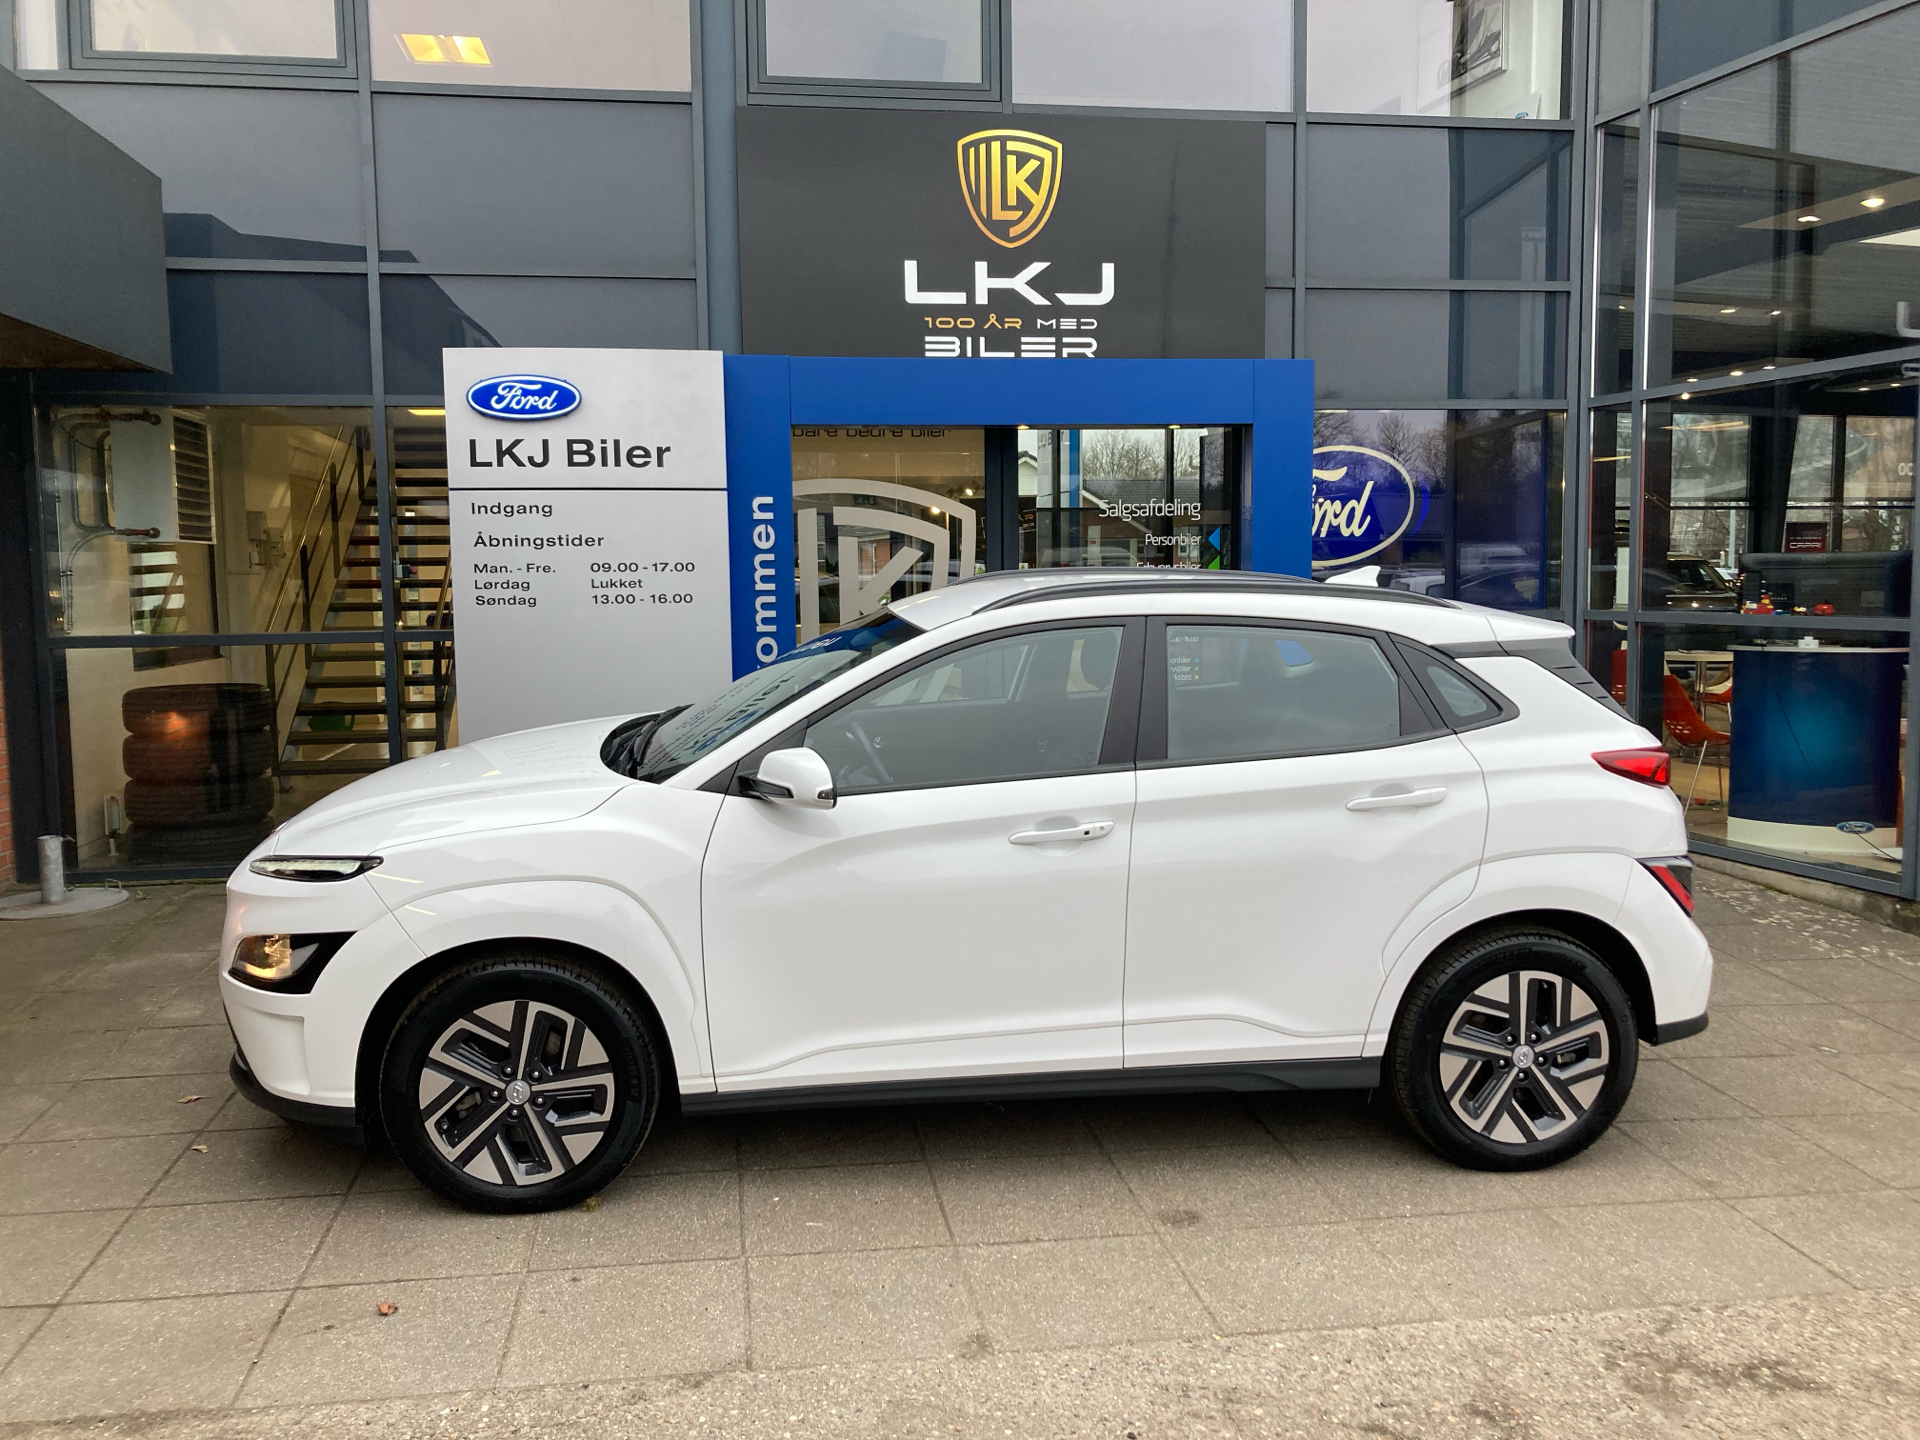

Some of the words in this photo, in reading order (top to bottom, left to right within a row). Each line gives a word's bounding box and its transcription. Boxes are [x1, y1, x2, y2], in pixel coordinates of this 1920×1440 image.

[904, 259, 1115, 306] LKJ
[924, 317, 976, 329] 100
[983, 313, 1022, 329] ÅR
[1037, 318, 1098, 330] MED
[924, 336, 1098, 358] BILER
[490, 382, 559, 410] Ford
[469, 438, 550, 468] LKJ
[566, 438, 671, 468] Biler
[471, 502, 553, 518] Indgang
[1099, 498, 1201, 521] Salgsafdeling
[1312, 466, 1374, 538] rd
[473, 531, 605, 550] Åbningstider
[1145, 533, 1201, 546] Personbiler
[473, 563, 513, 574] Man.
[526, 563, 556, 574] Fre.
[590, 562, 639, 573] 09.00
[651, 562, 695, 573] 17.00
[474, 579, 531, 592] Lørdag
[591, 578, 643, 589] Lukket
[752, 496, 778, 669] ommen
[475, 595, 537, 608] Søndag
[591, 594, 636, 605] 13.00
[650, 593, 693, 604] 16.00
